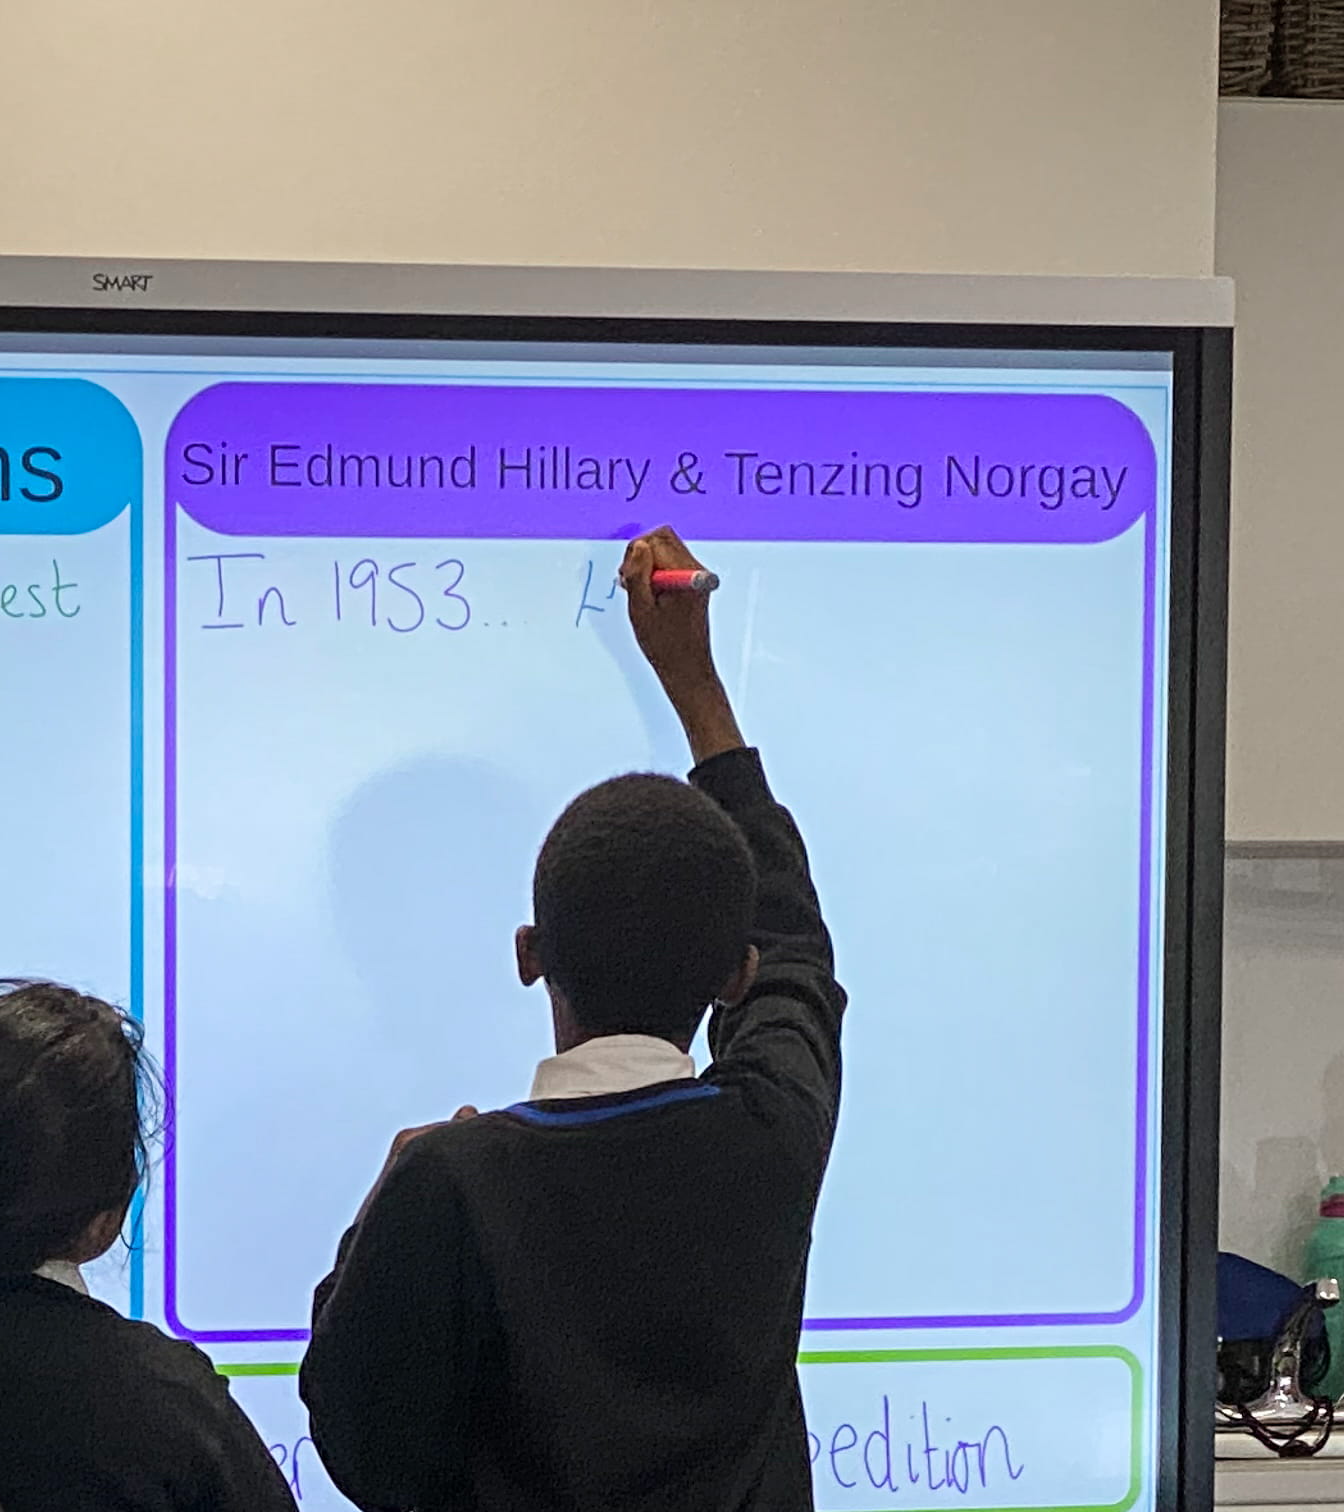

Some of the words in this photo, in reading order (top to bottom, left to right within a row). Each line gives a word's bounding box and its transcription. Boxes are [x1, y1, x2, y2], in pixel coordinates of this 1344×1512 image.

[92, 273, 153, 292] SMART
[181, 441, 249, 486] Sir
[268, 443, 478, 488] Edmund
[498, 445, 652, 502] Hillary
[669, 451, 707, 495] &
[724, 450, 923, 509] Tenzing
[945, 454, 1129, 511] Norgay
[183, 552, 298, 630] In
[808, 1393, 1025, 1495] edition
